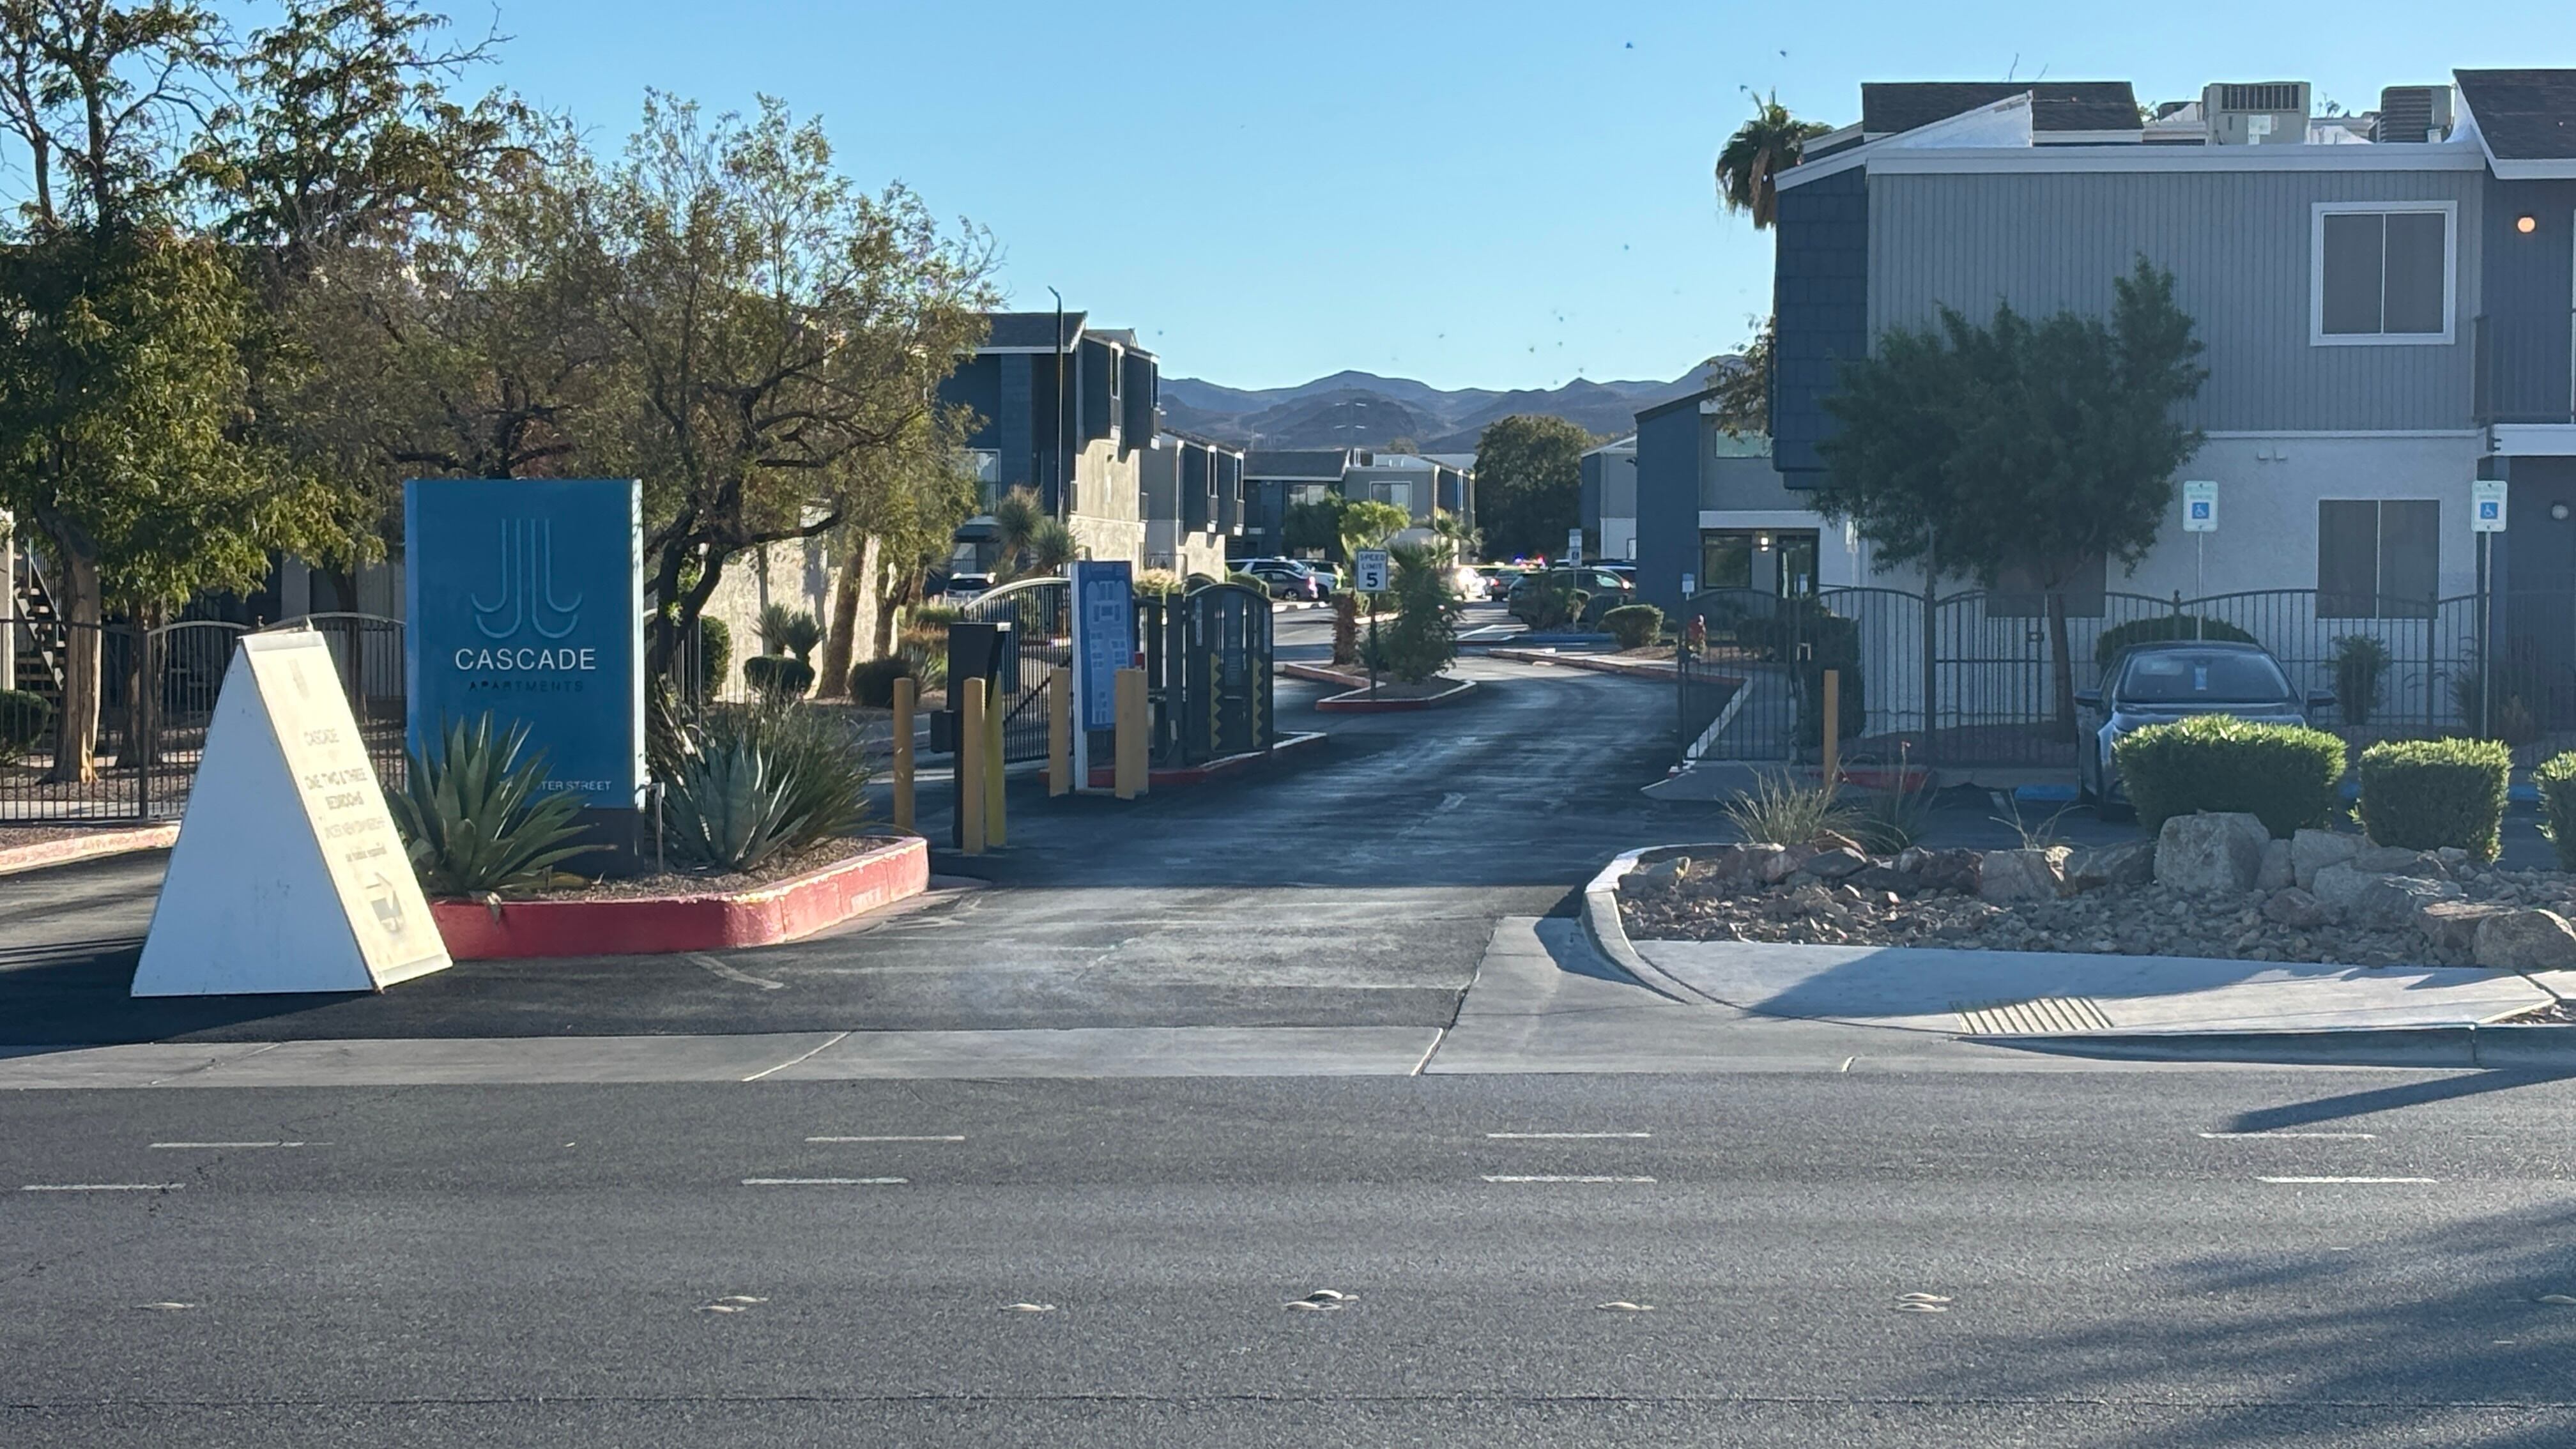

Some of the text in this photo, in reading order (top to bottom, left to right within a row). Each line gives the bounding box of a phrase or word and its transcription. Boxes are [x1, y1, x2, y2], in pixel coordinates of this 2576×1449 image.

[1366, 572, 1379, 588] 5
[455, 648, 597, 670] CASCADE
[468, 680, 584, 693] APARTMENTS
[566, 780, 612, 792] STREET
